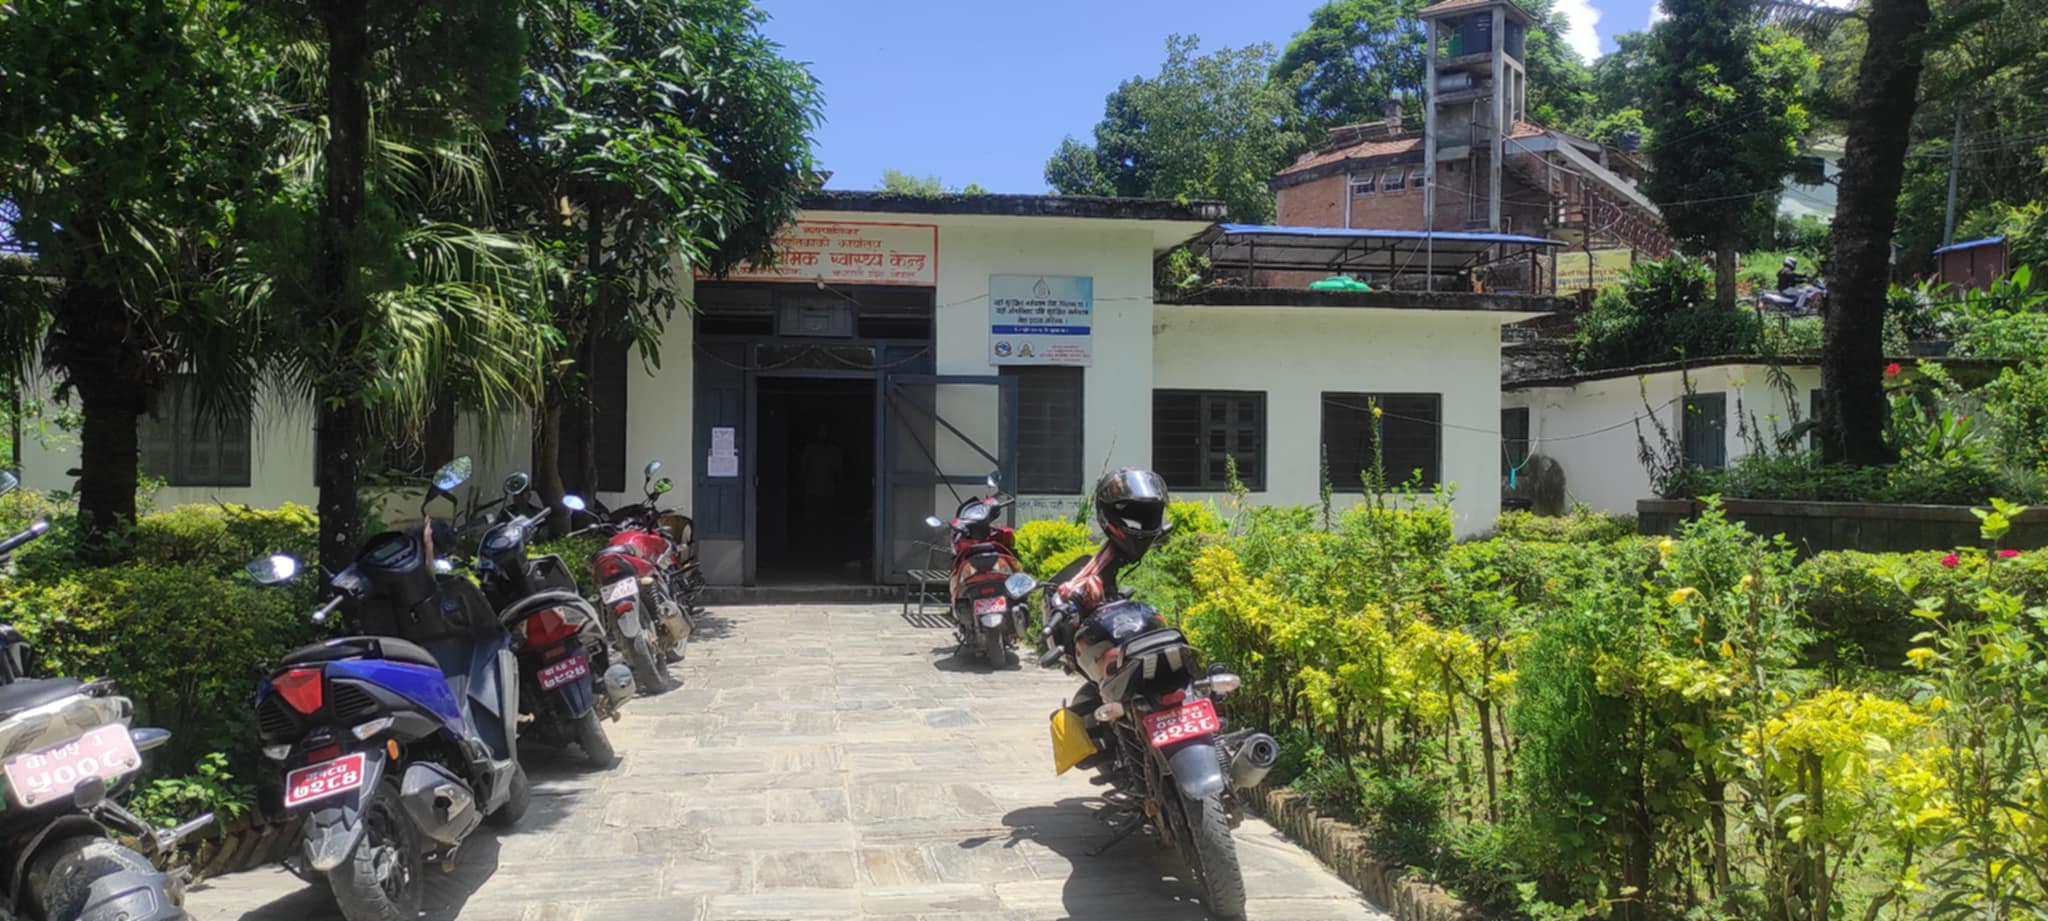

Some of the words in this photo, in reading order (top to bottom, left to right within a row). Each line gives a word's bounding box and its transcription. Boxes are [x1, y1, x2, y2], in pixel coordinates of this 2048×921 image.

[829, 252, 883, 267] स्वास्थ्य
[889, 249, 926, 271] केन्द्र
[293, 771, 358, 799] ७२८४
